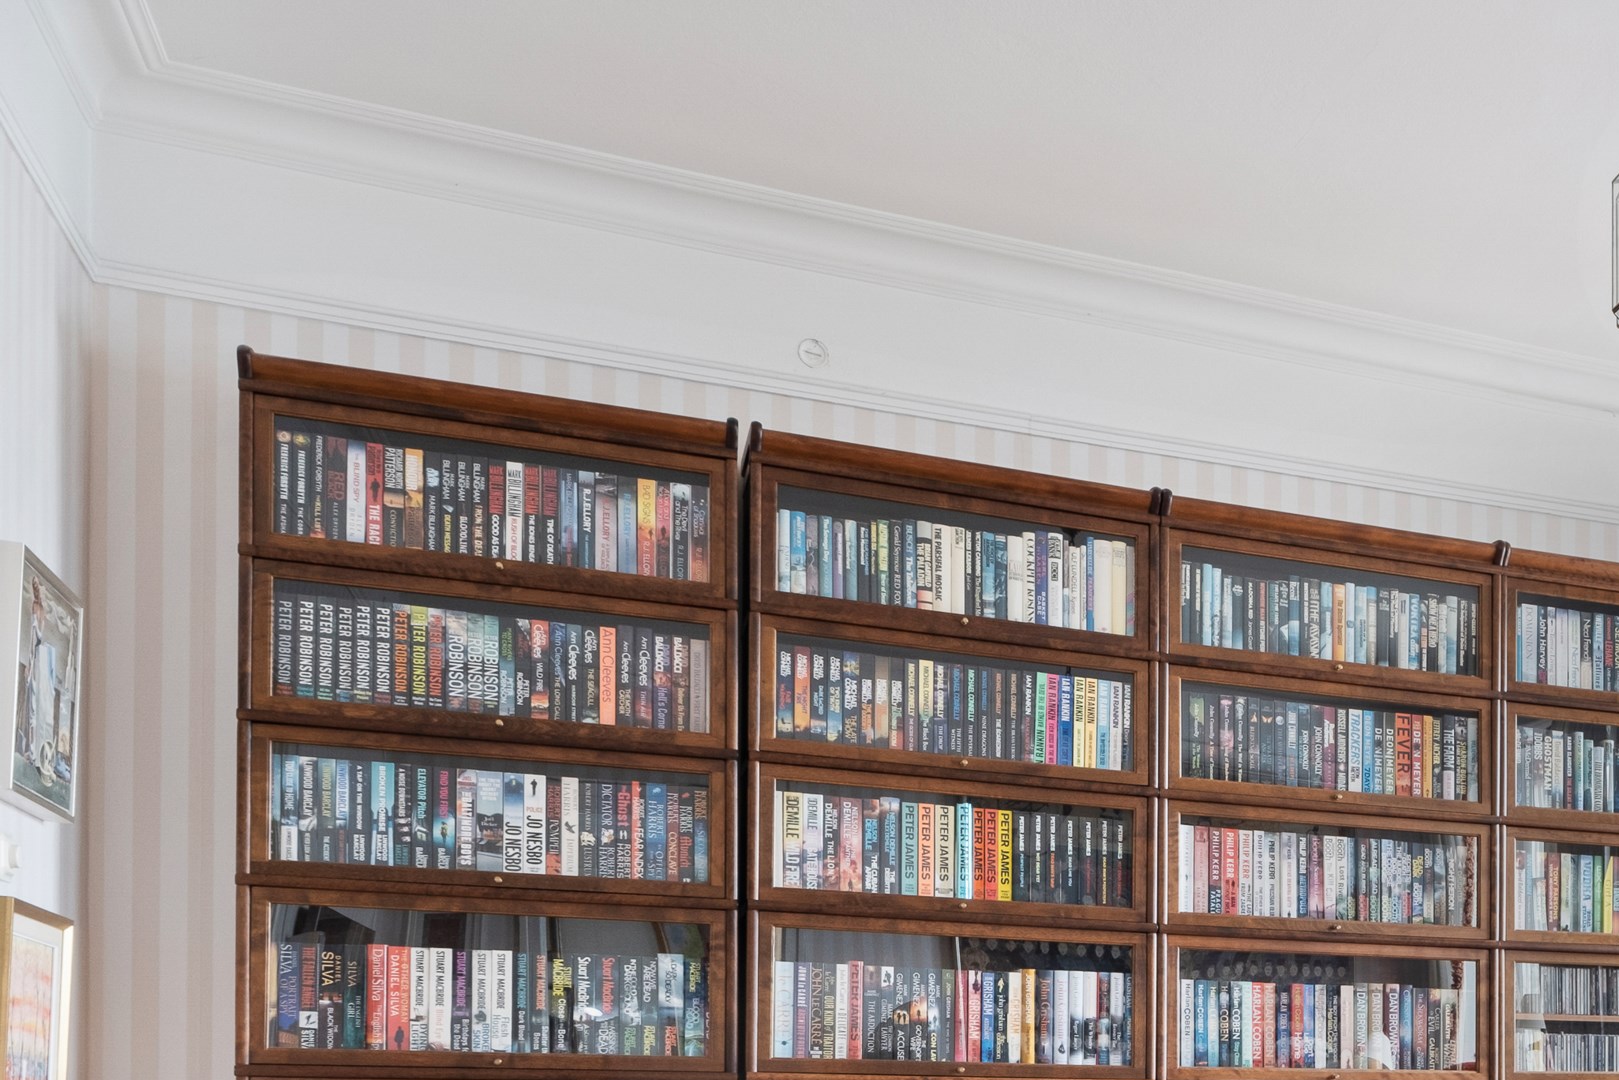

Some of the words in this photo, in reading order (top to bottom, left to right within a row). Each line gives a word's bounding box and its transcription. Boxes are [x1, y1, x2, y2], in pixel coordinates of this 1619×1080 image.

[385, 448, 395, 488] PATTERSON
[297, 478, 305, 503] FORSYTH
[508, 479, 521, 517] BILLINGHAM
[369, 505, 380, 520] THE
[934, 541, 942, 572] PARSIFAL
[279, 601, 292, 631] PETER
[320, 604, 332, 633] PETER
[377, 608, 389, 638] PETER
[395, 611, 407, 640] PETER
[1429, 617, 1437, 625] ME
[1583, 619, 1591, 637] Nicci
[602, 629, 613, 654] Ann
[1429, 631, 1437, 647] HERO
[1538, 639, 1546, 669] Harvey
[1583, 638, 1591, 661] French
[278, 634, 291, 683] ROBINSON
[320, 637, 332, 686] ROBINSON
[377, 642, 389, 692] ROBINSON
[395, 644, 407, 692] ROBINSON
[449, 635, 463, 697] ROBINSON
[569, 644, 579, 680] Cleeves
[639, 651, 650, 686] Cleeves
[602, 656, 614, 703] Cleeves
[1337, 734, 1345, 762] ANDREWS
[1351, 713, 1360, 765] TRACKERS
[1397, 716, 1409, 773] FEVER
[1444, 730, 1453, 744] THE
[1444, 746, 1453, 767] FARM
[1544, 736, 1552, 790] GHOSTMAN
[304, 762, 312, 788] LINWOOD
[418, 768, 426, 800] ELEVATOR
[440, 771, 448, 785] FIND
[303, 789, 312, 816] BARCLAY
[440, 786, 448, 799] YOU
[602, 784, 612, 825] DICTATOR
[417, 802, 426, 818] Pitch
[440, 801, 448, 818] FIRST
[461, 797, 472, 842] BALTIMORE
[527, 815, 542, 830] JO
[786, 801, 798, 838] DEMILLE
[906, 805, 914, 839] PETER
[940, 807, 948, 841] PETER
[549, 820, 559, 854] POMPEII
[635, 828, 644, 849] FEAR
[1001, 813, 1010, 846] PETER
[461, 844, 472, 865] BOYS
[527, 832, 542, 864] NESBO
[669, 832, 677, 875] CONCLAVE
[905, 842, 914, 878] JAMES
[940, 845, 948, 881] JAMES
[634, 852, 644, 878] INDEX
[1001, 850, 1010, 884] JAMES
[322, 951, 334, 986] SILVA
[373, 949, 383, 977] Daniel
[391, 955, 399, 988] DANIEL
[436, 951, 444, 973] STUART
[372, 979, 384, 1001] Silva
[435, 975, 444, 1006] MACBRIDE
[553, 959, 563, 995] MACBRIDE
[558, 999, 566, 1018] Close
[813, 967, 822, 995] JOHN
[1040, 979, 1050, 999] John
[390, 992, 399, 1016] SILVA
[984, 981, 993, 1015] GRISHAM
[812, 1008, 823, 1044] CARRÉ
[1040, 1002, 1050, 1038] Grisham
[1357, 1014, 1365, 1046] BROWN
[1253, 1027, 1261, 1059] COBEN
